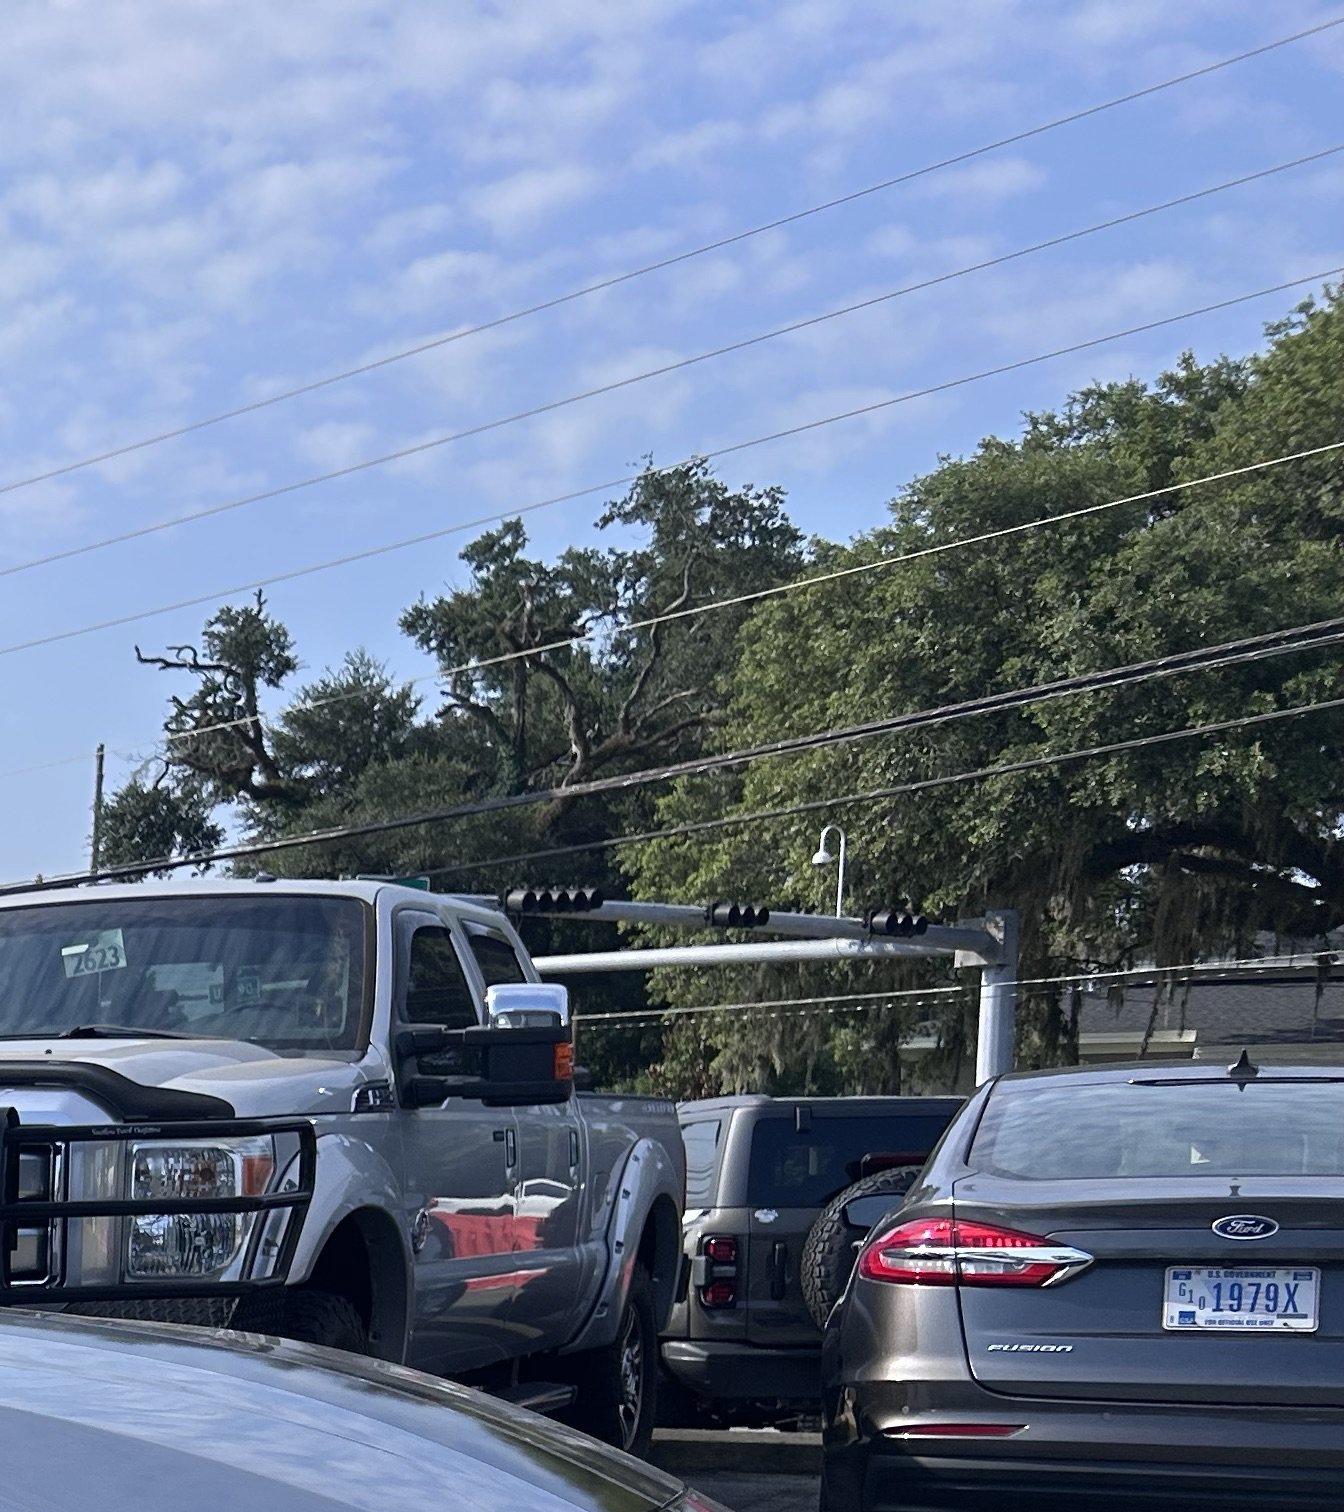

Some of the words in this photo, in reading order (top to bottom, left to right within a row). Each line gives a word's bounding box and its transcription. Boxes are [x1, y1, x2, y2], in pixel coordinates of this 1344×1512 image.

[73, 946, 121, 975] 2623
[1227, 1220, 1264, 1234] Ford
[1212, 1282, 1299, 1313] 1979X
[987, 1344, 1073, 1353] FUSION
